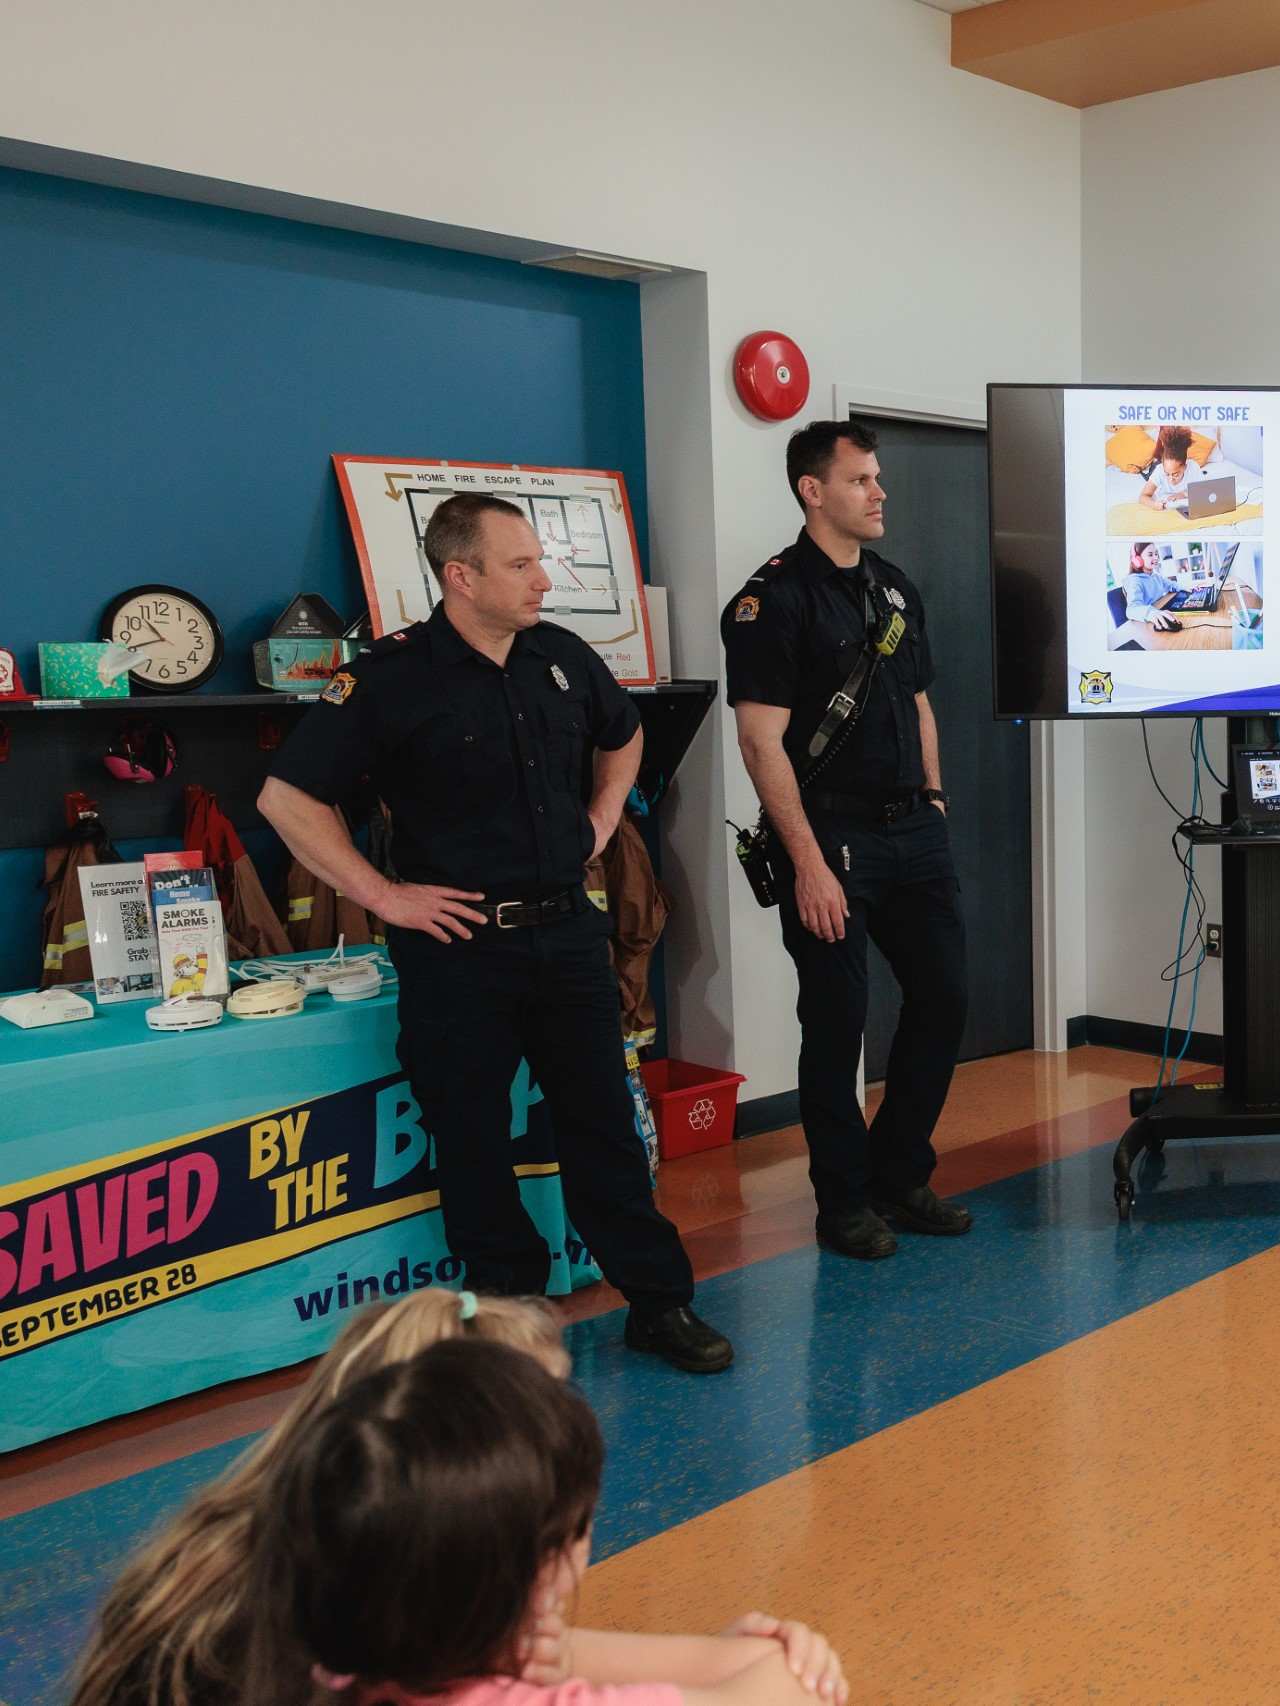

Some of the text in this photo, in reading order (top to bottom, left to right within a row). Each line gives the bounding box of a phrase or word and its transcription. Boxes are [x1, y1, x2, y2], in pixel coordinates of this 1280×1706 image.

[1118, 405, 1250, 422] SAFE OR NOT SAFE
[417, 473, 555, 486] HOME FIRE ESCAPE PLAN
[540, 509, 559, 518] Bath
[553, 584, 583, 593] Kitchen
[138, 605, 150, 620] 11
[152, 601, 170, 616] 12
[175, 607, 182, 622] 1
[125, 615, 142, 631] 10
[187, 619, 199, 633] 2
[119, 630, 132, 644] 9
[193, 636, 204, 650] 3
[187, 650, 199, 664] 4
[158, 664, 170, 679] 6
[176, 661, 187, 674] 5
[90, 880, 115, 889] Learn
[115, 879, 136, 887] more
[155, 874, 191, 890] Don't
[91, 886, 140, 897] FIRE SAFETY
[163, 908, 206, 919] SMOKE
[161, 917, 209, 929] ALARMS
[127, 947, 148, 956] Grab
[128, 954, 150, 962] STAY
[249, 1110, 311, 1181] BY
[268, 1152, 350, 1231] THE
[293, 1254, 466, 1322] windso
[0, 1263, 197, 1349] EPTEMBER 28
